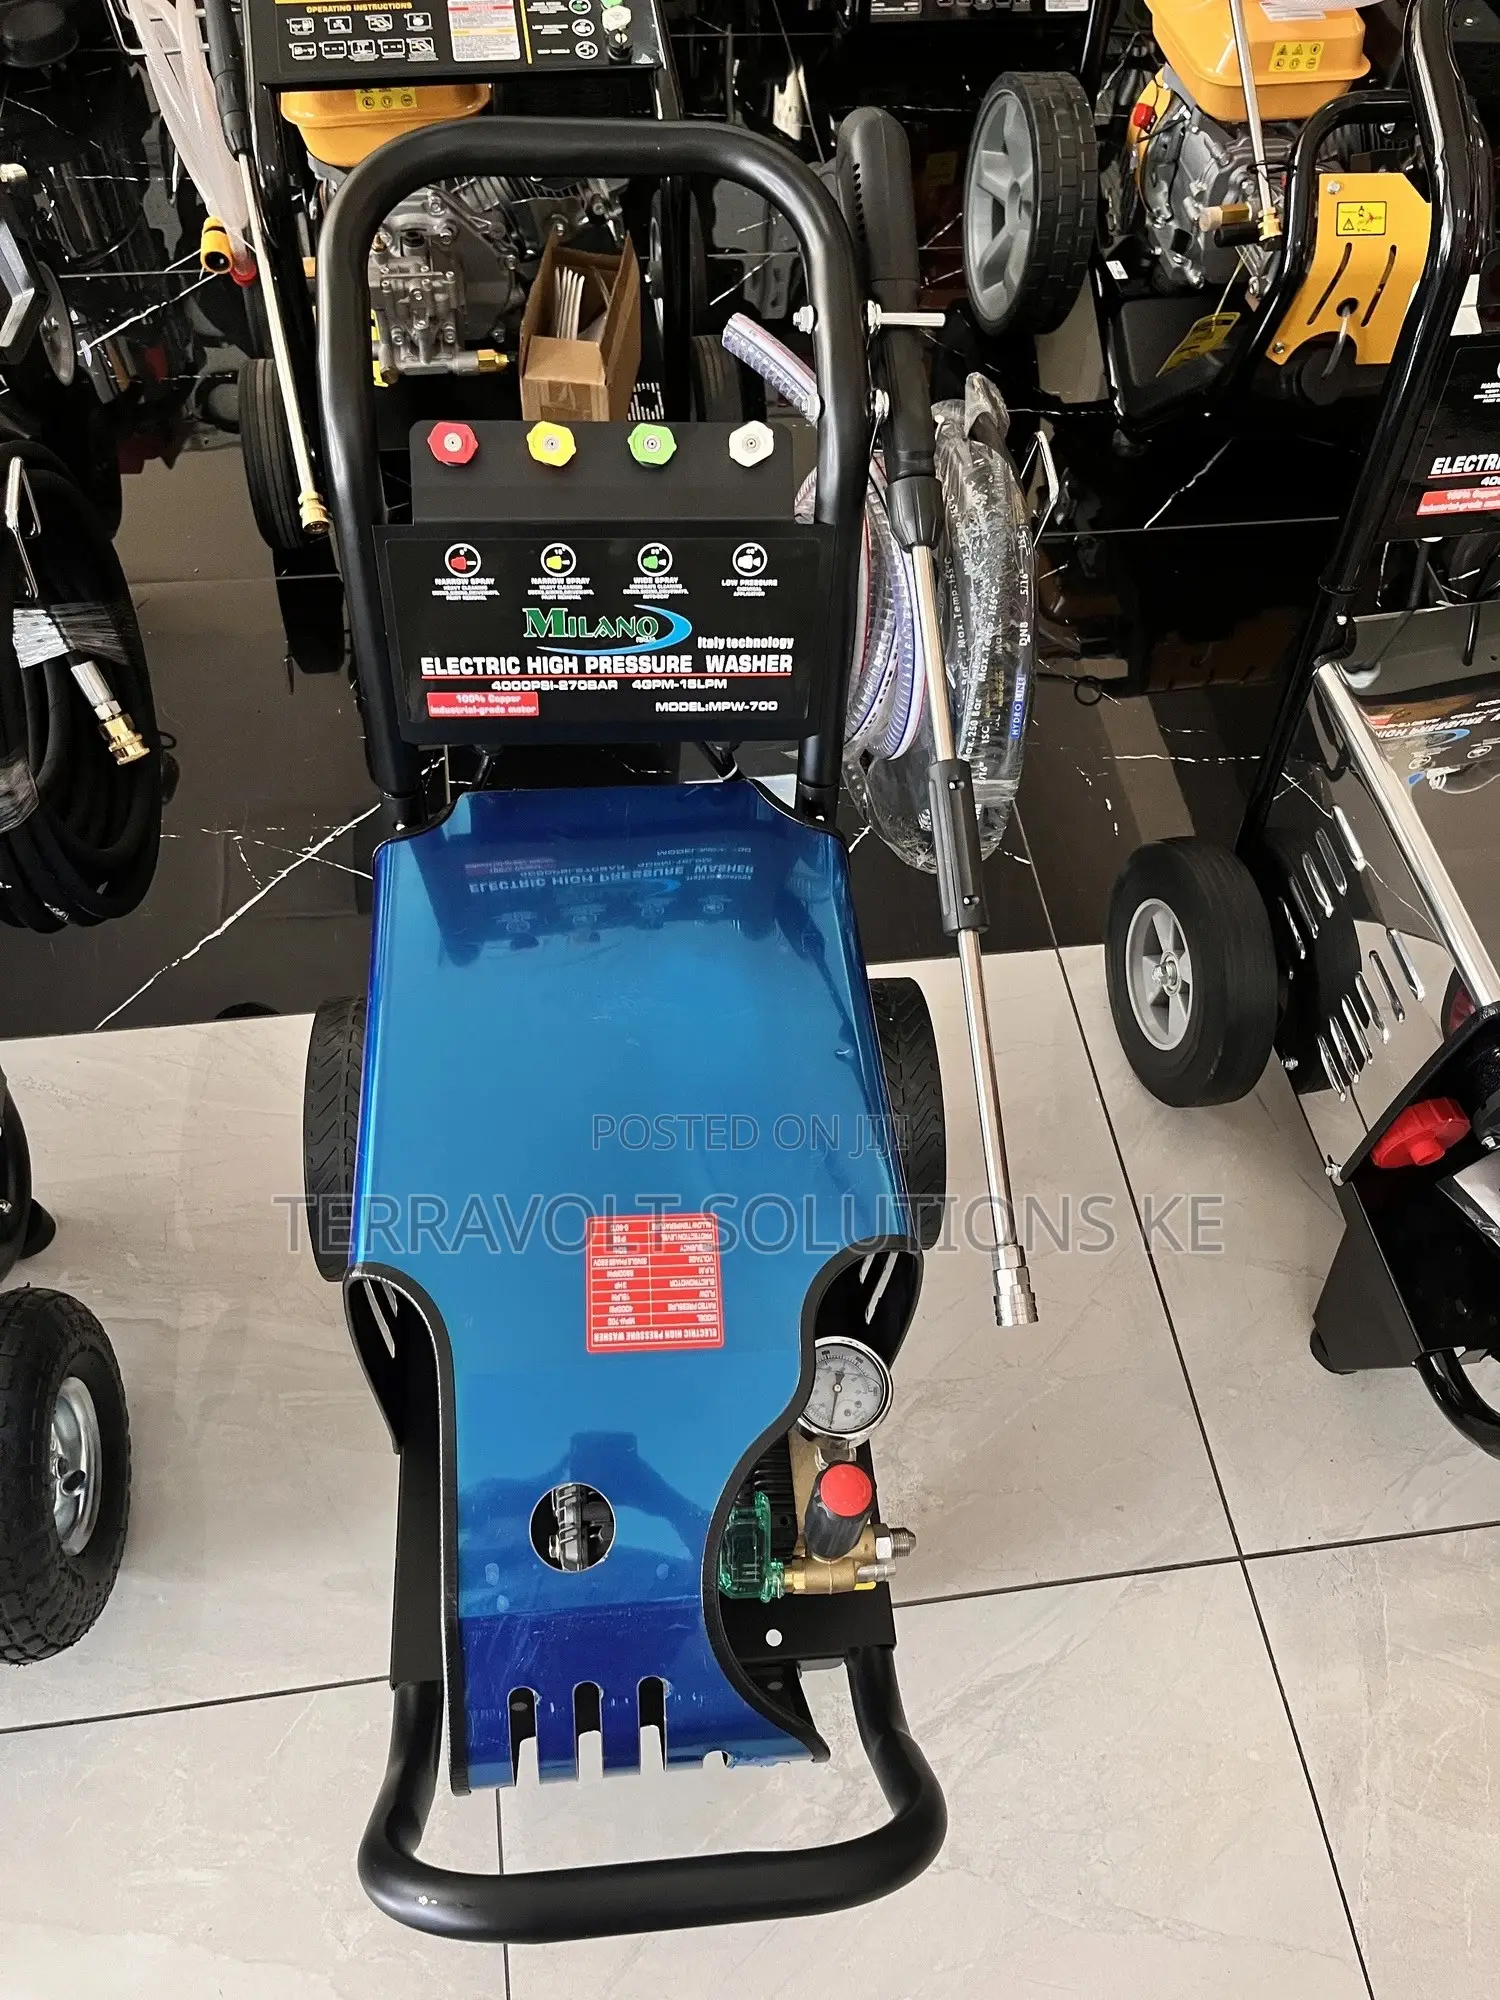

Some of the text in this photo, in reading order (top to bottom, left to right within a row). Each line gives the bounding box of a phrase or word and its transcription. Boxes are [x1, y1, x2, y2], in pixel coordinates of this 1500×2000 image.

[306, 2, 412, 14] OPERATING INSTRUCTIONS
[434, 578, 495, 586] NARROW SPRAY
[522, 608, 658, 638] MILANO
[1018, 622, 1030, 647] DN8
[698, 636, 794, 650] Italy technology
[420, 654, 793, 676] ELECTRIC HIGH PRESSURE WASHER
[456, 694, 486, 704] 100%
[508, 706, 536, 714] motor
[656, 700, 778, 712] MODEL:MPW-700
[970, 698, 982, 717] Bar
[688, 1254, 713, 1263] VOLTAGE
[698, 1290, 716, 1298] FLOW
[594, 1328, 717, 1342] ELECTRIC HIGH PRESSURE WASHER
